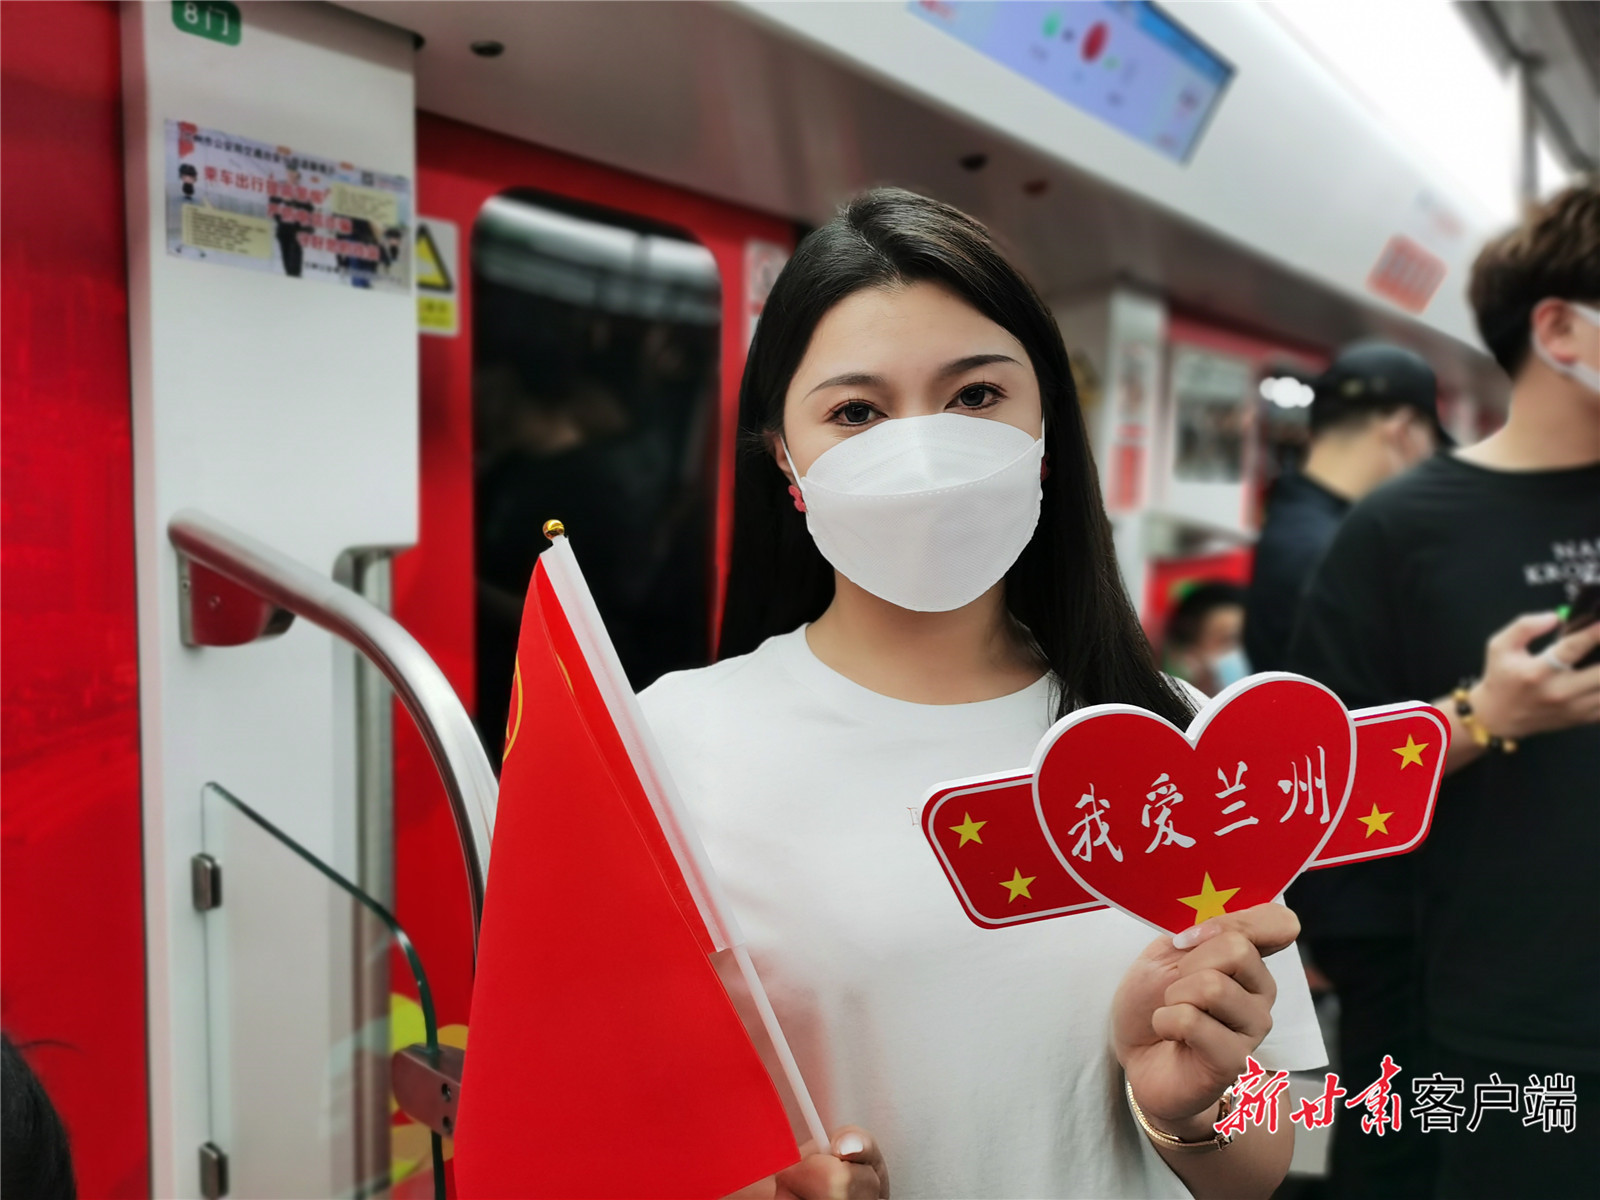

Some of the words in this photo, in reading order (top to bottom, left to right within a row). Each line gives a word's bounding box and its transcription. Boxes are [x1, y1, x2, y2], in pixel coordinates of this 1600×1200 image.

[184, 2, 229, 36] 8门
[1067, 745, 1331, 862] 我爱兰州
